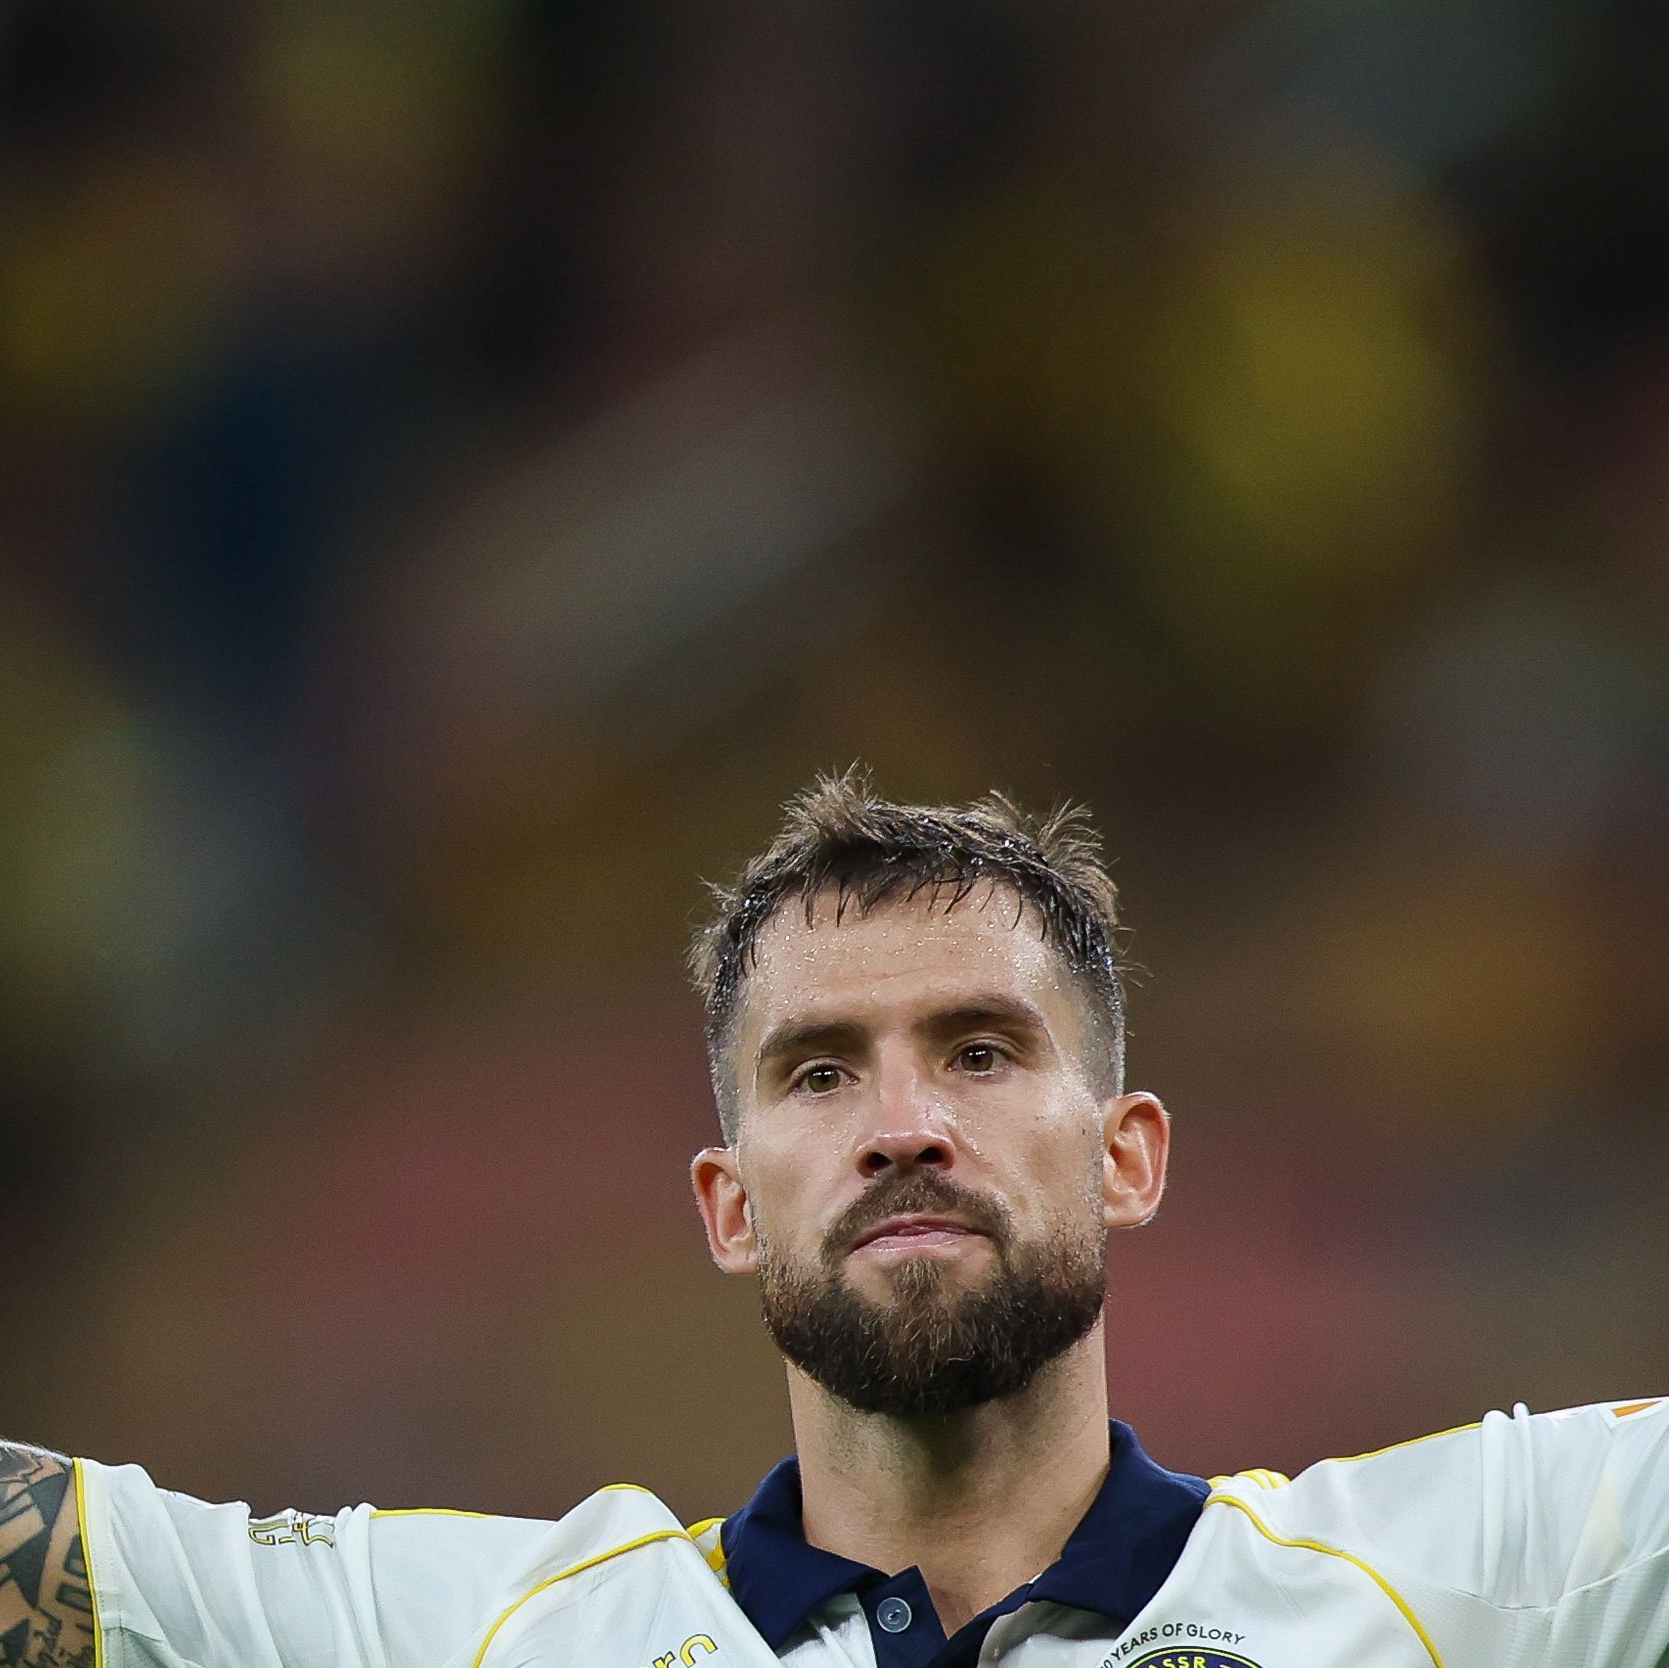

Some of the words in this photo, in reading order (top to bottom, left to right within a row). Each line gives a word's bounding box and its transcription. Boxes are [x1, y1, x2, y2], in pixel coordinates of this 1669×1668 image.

[1111, 1627, 1158, 1662] YEARS
[1162, 1623, 1184, 1637] OF
[1186, 1624, 1247, 1645] GLORY
